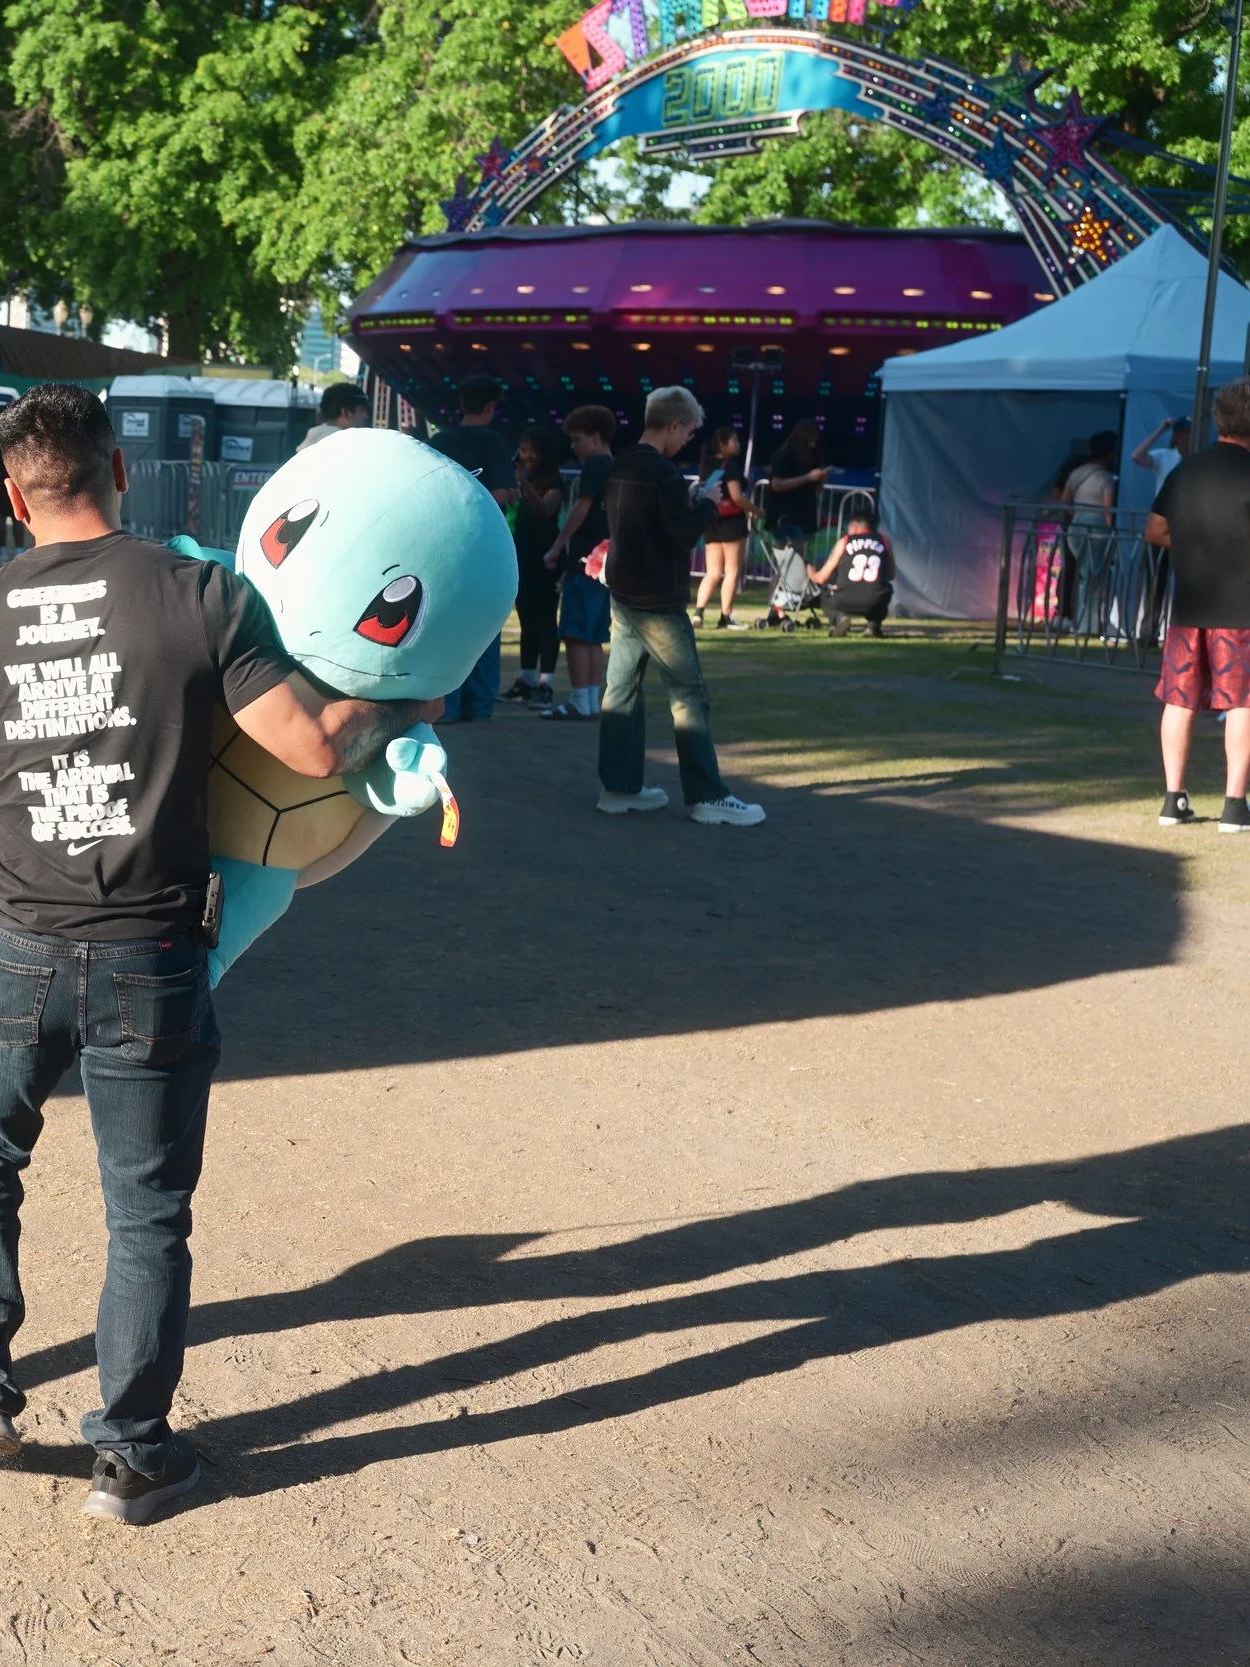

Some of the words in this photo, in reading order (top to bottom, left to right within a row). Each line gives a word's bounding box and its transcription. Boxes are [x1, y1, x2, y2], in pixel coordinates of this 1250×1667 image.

[663, 52, 783, 127] 2000
[846, 538, 885, 555] PIPPEN
[848, 553, 881, 583] 33
[6, 579, 107, 608] GREATNESS
[39, 604, 59, 625] IS
[60, 603, 77, 623] A
[15, 616, 106, 646] JOURNEY.
[4, 663, 37, 685] WE
[38, 656, 87, 681] WILL
[88, 651, 122, 675] ALL
[18, 675, 87, 702] ARRIVE
[90, 672, 114, 694] AT
[20, 691, 114, 720] DIFFERENT
[3, 705, 137, 740] DESTINATIONS.
[51, 753, 69, 771] IT
[72, 748, 91, 768] IS
[17, 771, 53, 792] THE
[55, 761, 136, 788] ARRIVAL
[40, 785, 89, 807] THAT
[90, 783, 110, 804] IS
[27, 805, 65, 823] THE
[64, 797, 129, 822] PROOF
[31, 822, 57, 842] OF
[57, 814, 136, 841] SUCCESS.
